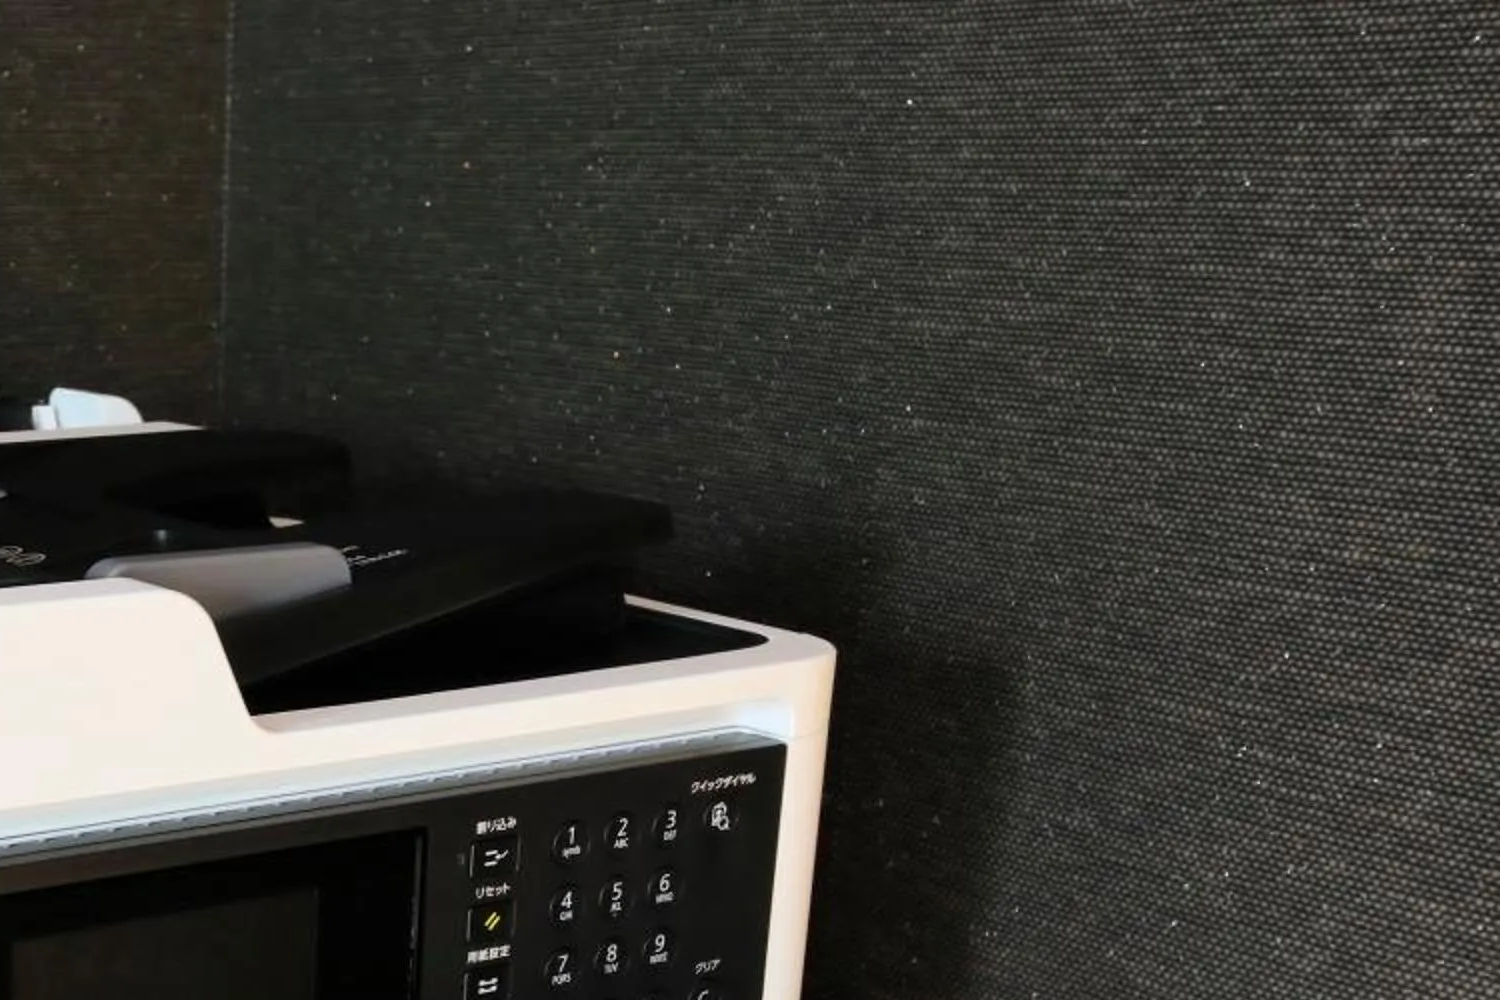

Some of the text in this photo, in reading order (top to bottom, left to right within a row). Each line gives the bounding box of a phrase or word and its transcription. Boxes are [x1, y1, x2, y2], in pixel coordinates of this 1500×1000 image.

[617, 817, 629, 837] 2
[665, 809, 677, 829] 3
[568, 826, 575, 845] 1
[475, 882, 511, 899] リセット
[612, 881, 623, 901] 5
[659, 873, 671, 892] 6
[560, 890, 573, 909] 4
[606, 943, 618, 963] 8
[655, 933, 666, 953] 9
[558, 953, 569, 973] 7
[695, 959, 721, 975] クリア
